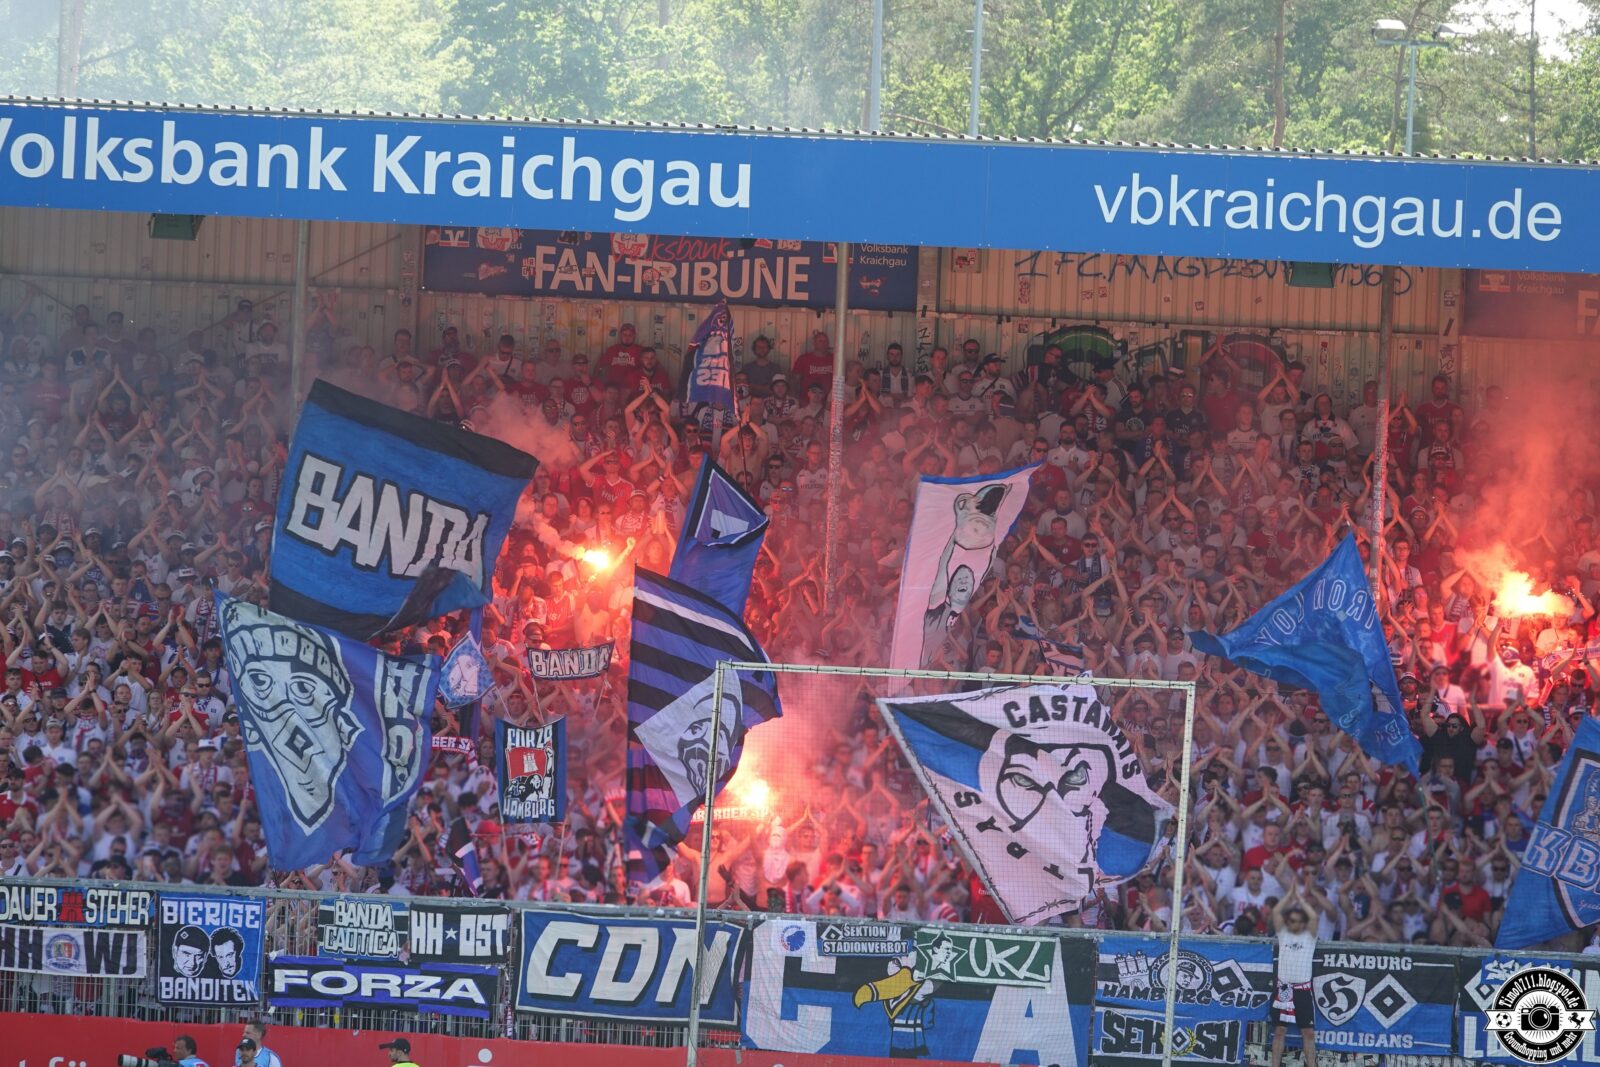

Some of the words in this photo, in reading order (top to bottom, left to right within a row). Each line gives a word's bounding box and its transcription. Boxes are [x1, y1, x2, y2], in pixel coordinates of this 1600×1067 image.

[373, 134, 750, 222] Kraichgau
[1094, 173, 1562, 248] vbkraichgau.de
[860, 243, 909, 254] Volksbank
[860, 256, 907, 267] Kraichgau
[534, 245, 811, 301] FAN-TRIBÜNE
[1108, 252, 1288, 283] MAGDEBU
[1517, 272, 1566, 282] Volksbank
[1517, 285, 1565, 295] Kraichgau
[287, 454, 488, 590] BANDA
[531, 647, 612, 676] BANDA
[507, 724, 553, 748] FORZA
[503, 799, 555, 819] HAMBURG
[0, 886, 57, 921] DAUER
[86, 888, 151, 925] STEHER
[162, 901, 260, 929] BIERIGE
[334, 900, 394, 930] BANDA
[324, 925, 400, 957] CAOTICA
[411, 910, 443, 956] HH
[459, 914, 508, 957] OST
[843, 924, 886, 938] SEKTION
[823, 940, 908, 954] STADIONVERBOT
[526, 921, 732, 1005] CDN
[1323, 954, 1413, 971] HAMBURG
[160, 977, 259, 1002] BANDITEN
[274, 969, 486, 1005] FORZA
[1102, 983, 1213, 1005] HAMBRG
[1313, 1030, 1414, 1049] HOOLIGANS
